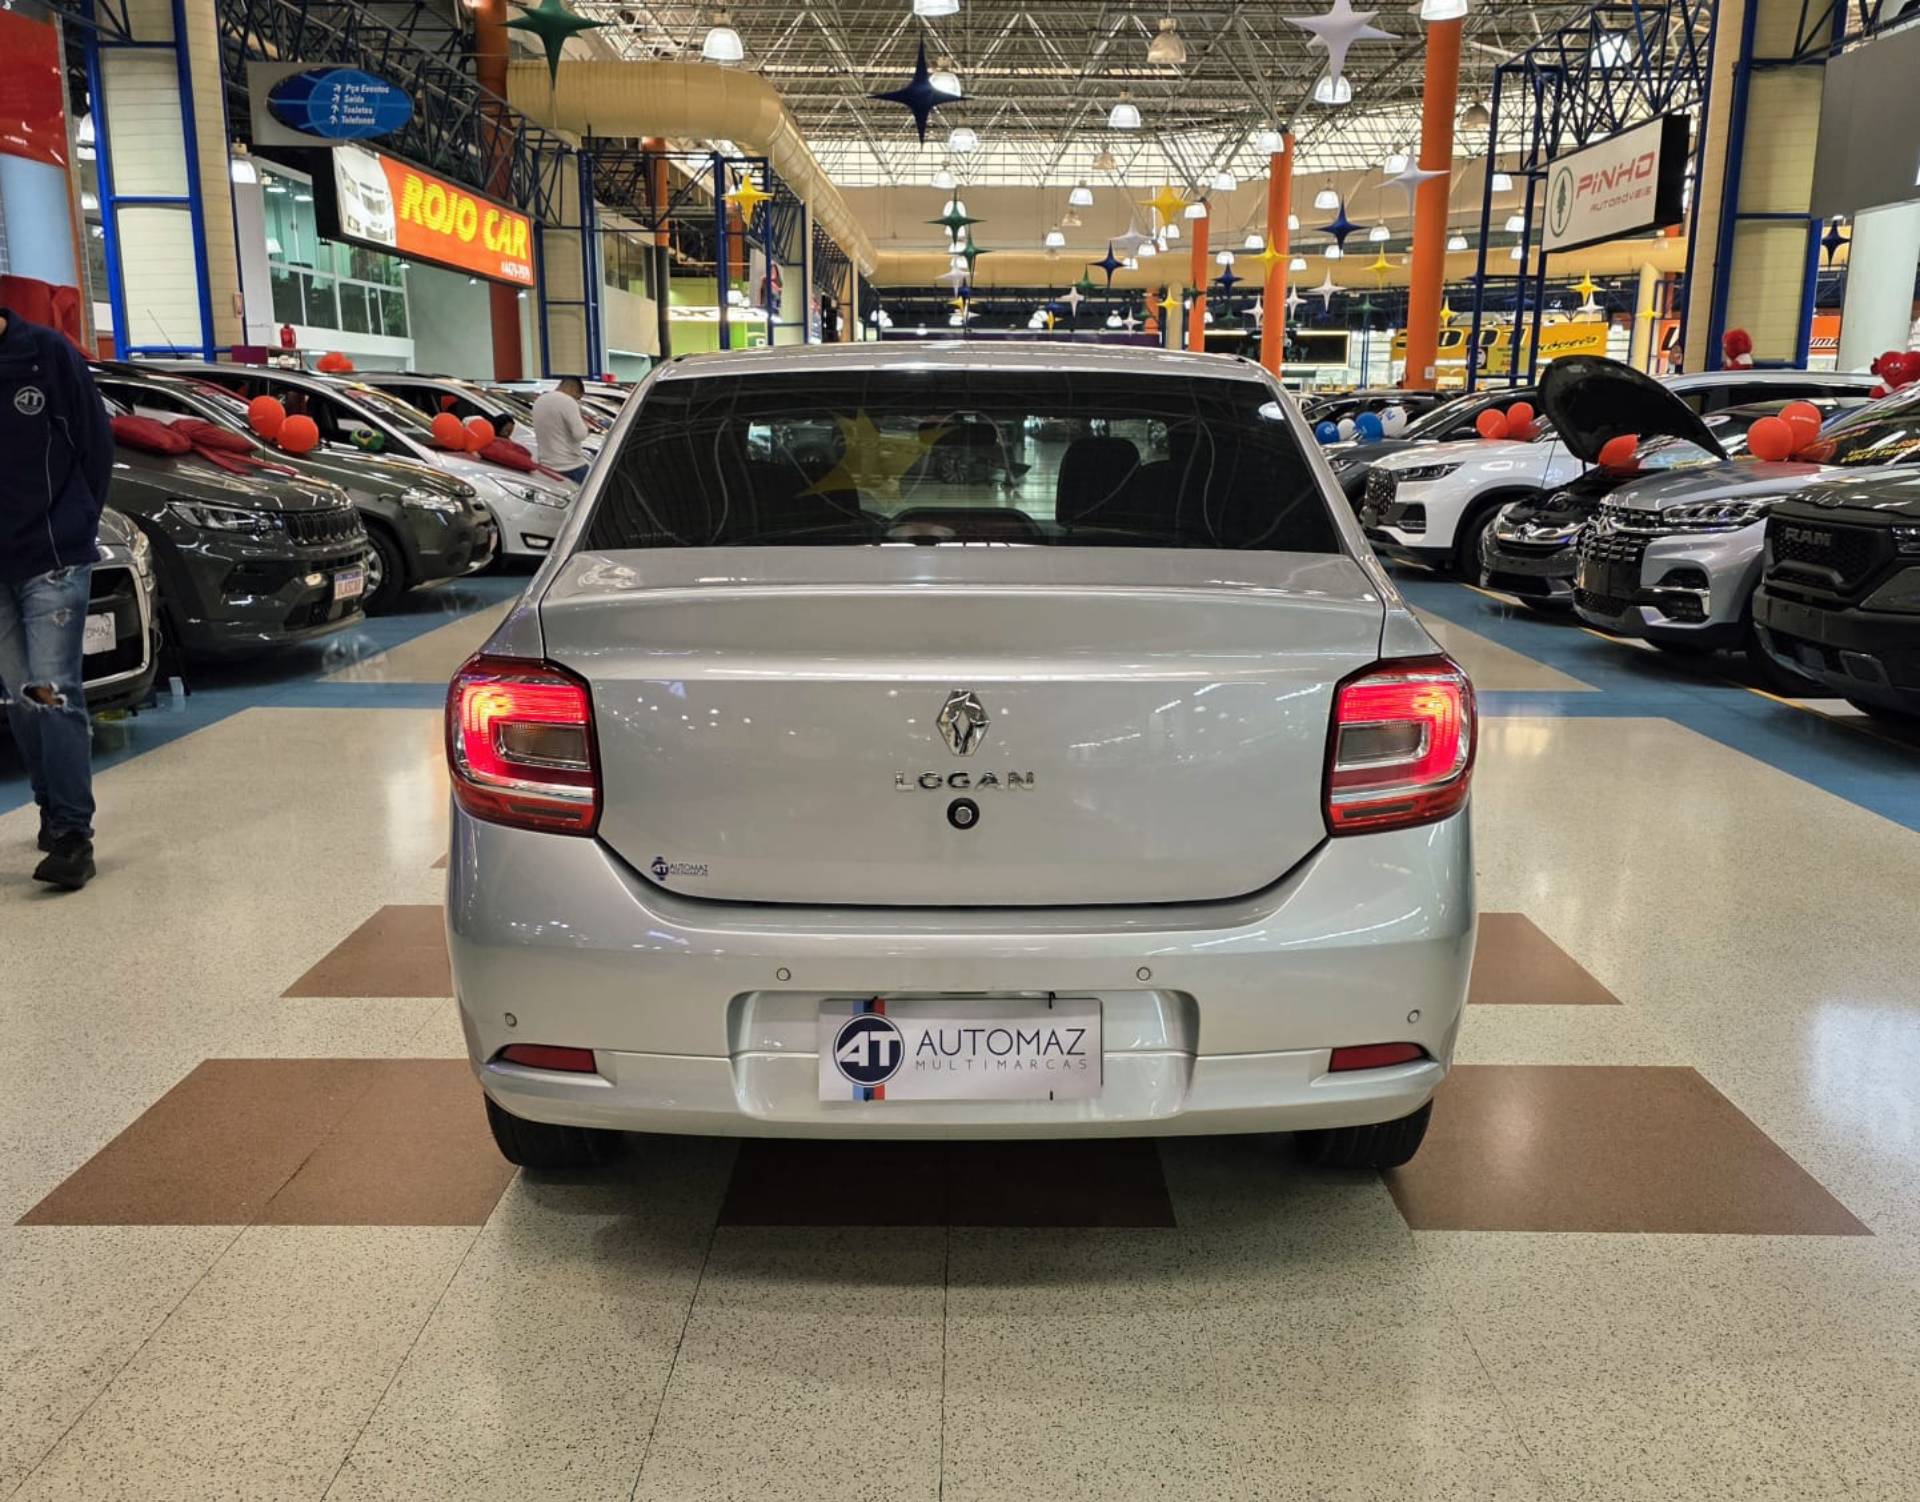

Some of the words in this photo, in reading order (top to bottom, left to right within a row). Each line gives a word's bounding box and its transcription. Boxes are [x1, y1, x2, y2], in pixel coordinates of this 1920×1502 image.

[400, 174, 478, 243] ROJO
[482, 208, 528, 260] CAR
[1784, 527, 1832, 547] RAM
[895, 771, 1035, 792] LOGAN
[916, 1029, 1086, 1056] AUTOMAZ
[915, 1059, 1088, 1071] MULTIMARCAS
